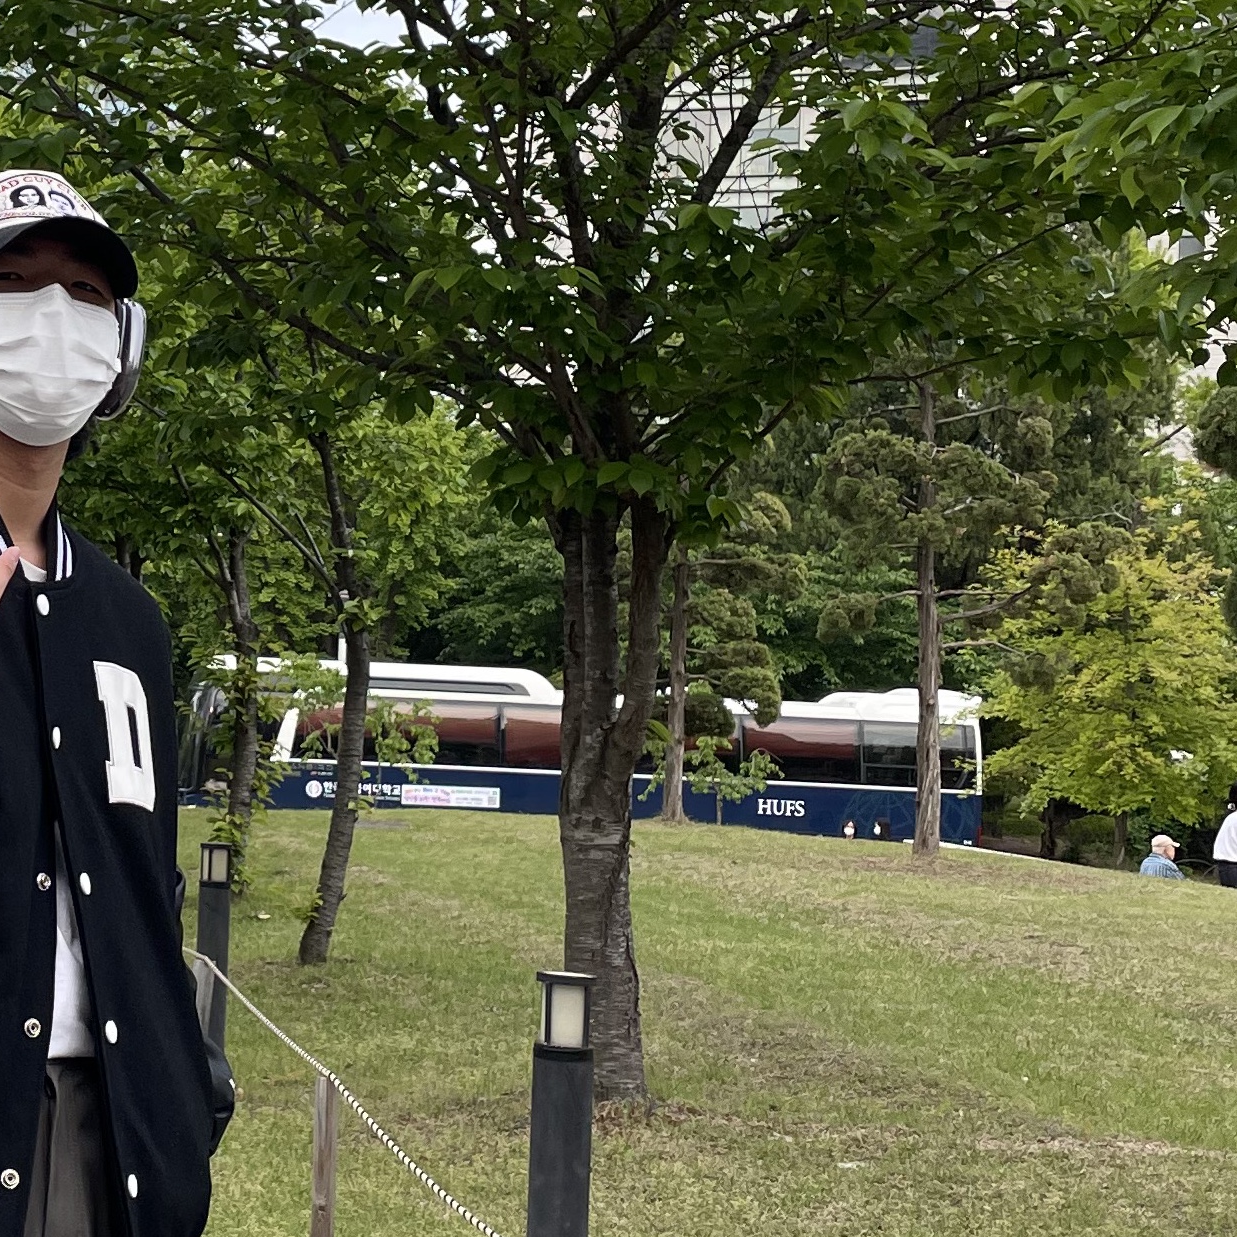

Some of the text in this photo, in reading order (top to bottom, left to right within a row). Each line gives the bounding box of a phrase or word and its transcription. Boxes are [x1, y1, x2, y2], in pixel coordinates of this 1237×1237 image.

[23, 176, 53, 185] GUY
[93, 661, 156, 813] D
[757, 798, 806, 817] HUFS
